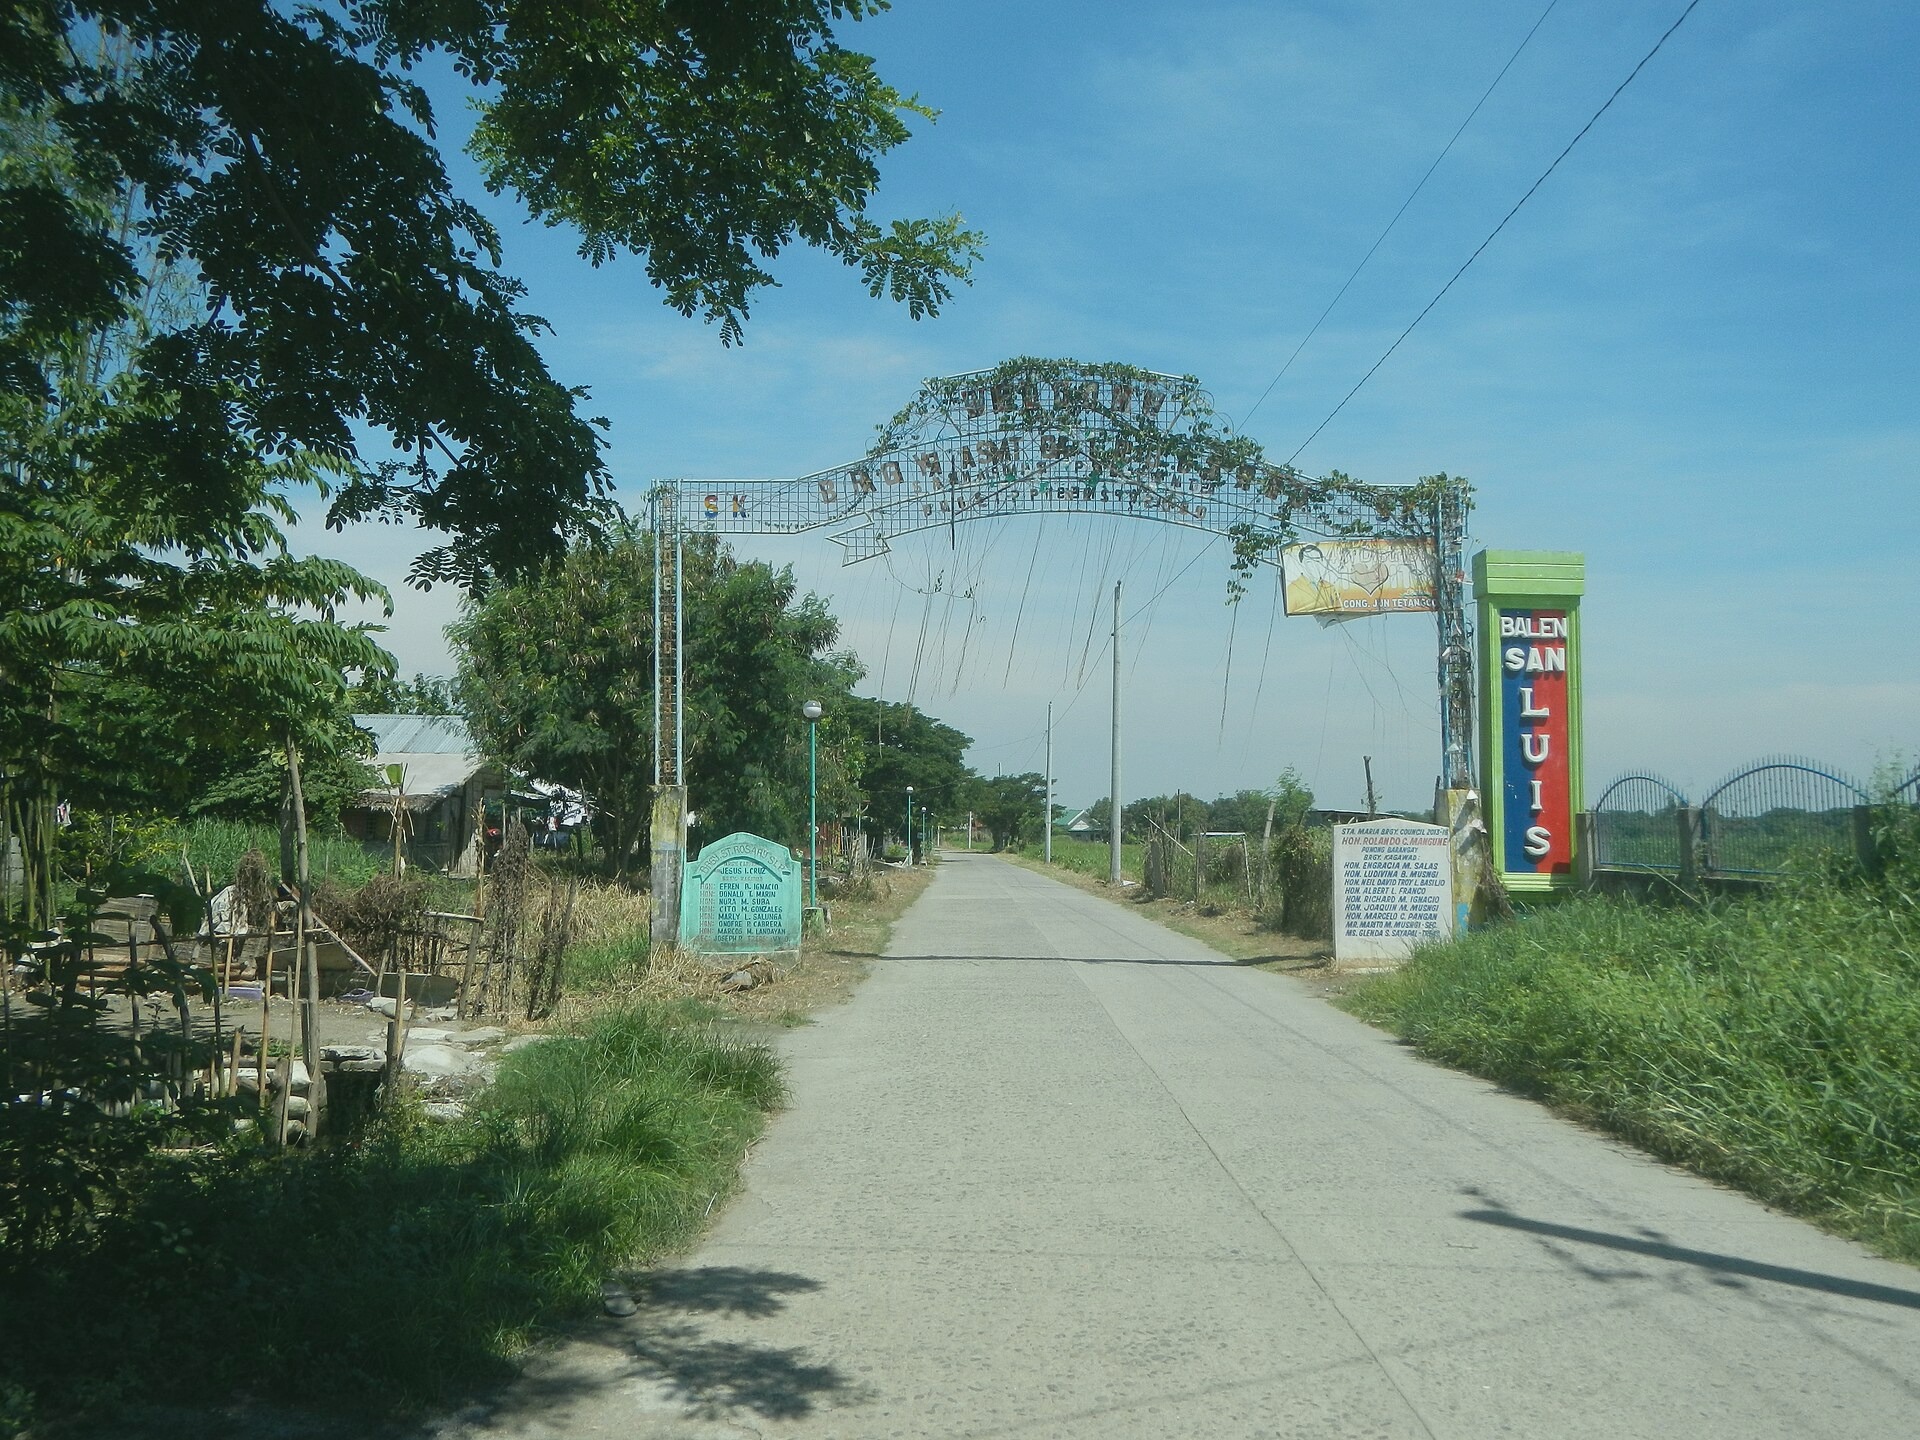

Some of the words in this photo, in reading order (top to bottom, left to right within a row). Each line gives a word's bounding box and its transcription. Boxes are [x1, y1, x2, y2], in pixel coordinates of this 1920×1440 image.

[704, 495, 748, 519] SK
[1343, 599, 1371, 609] CONG.
[1500, 616, 1567, 639] BALEN
[1505, 647, 1565, 671] SAN
[1342, 837, 1361, 845] HON.
[1364, 837, 1400, 845] ROLANDO
[1410, 837, 1448, 845] MANGUNE
